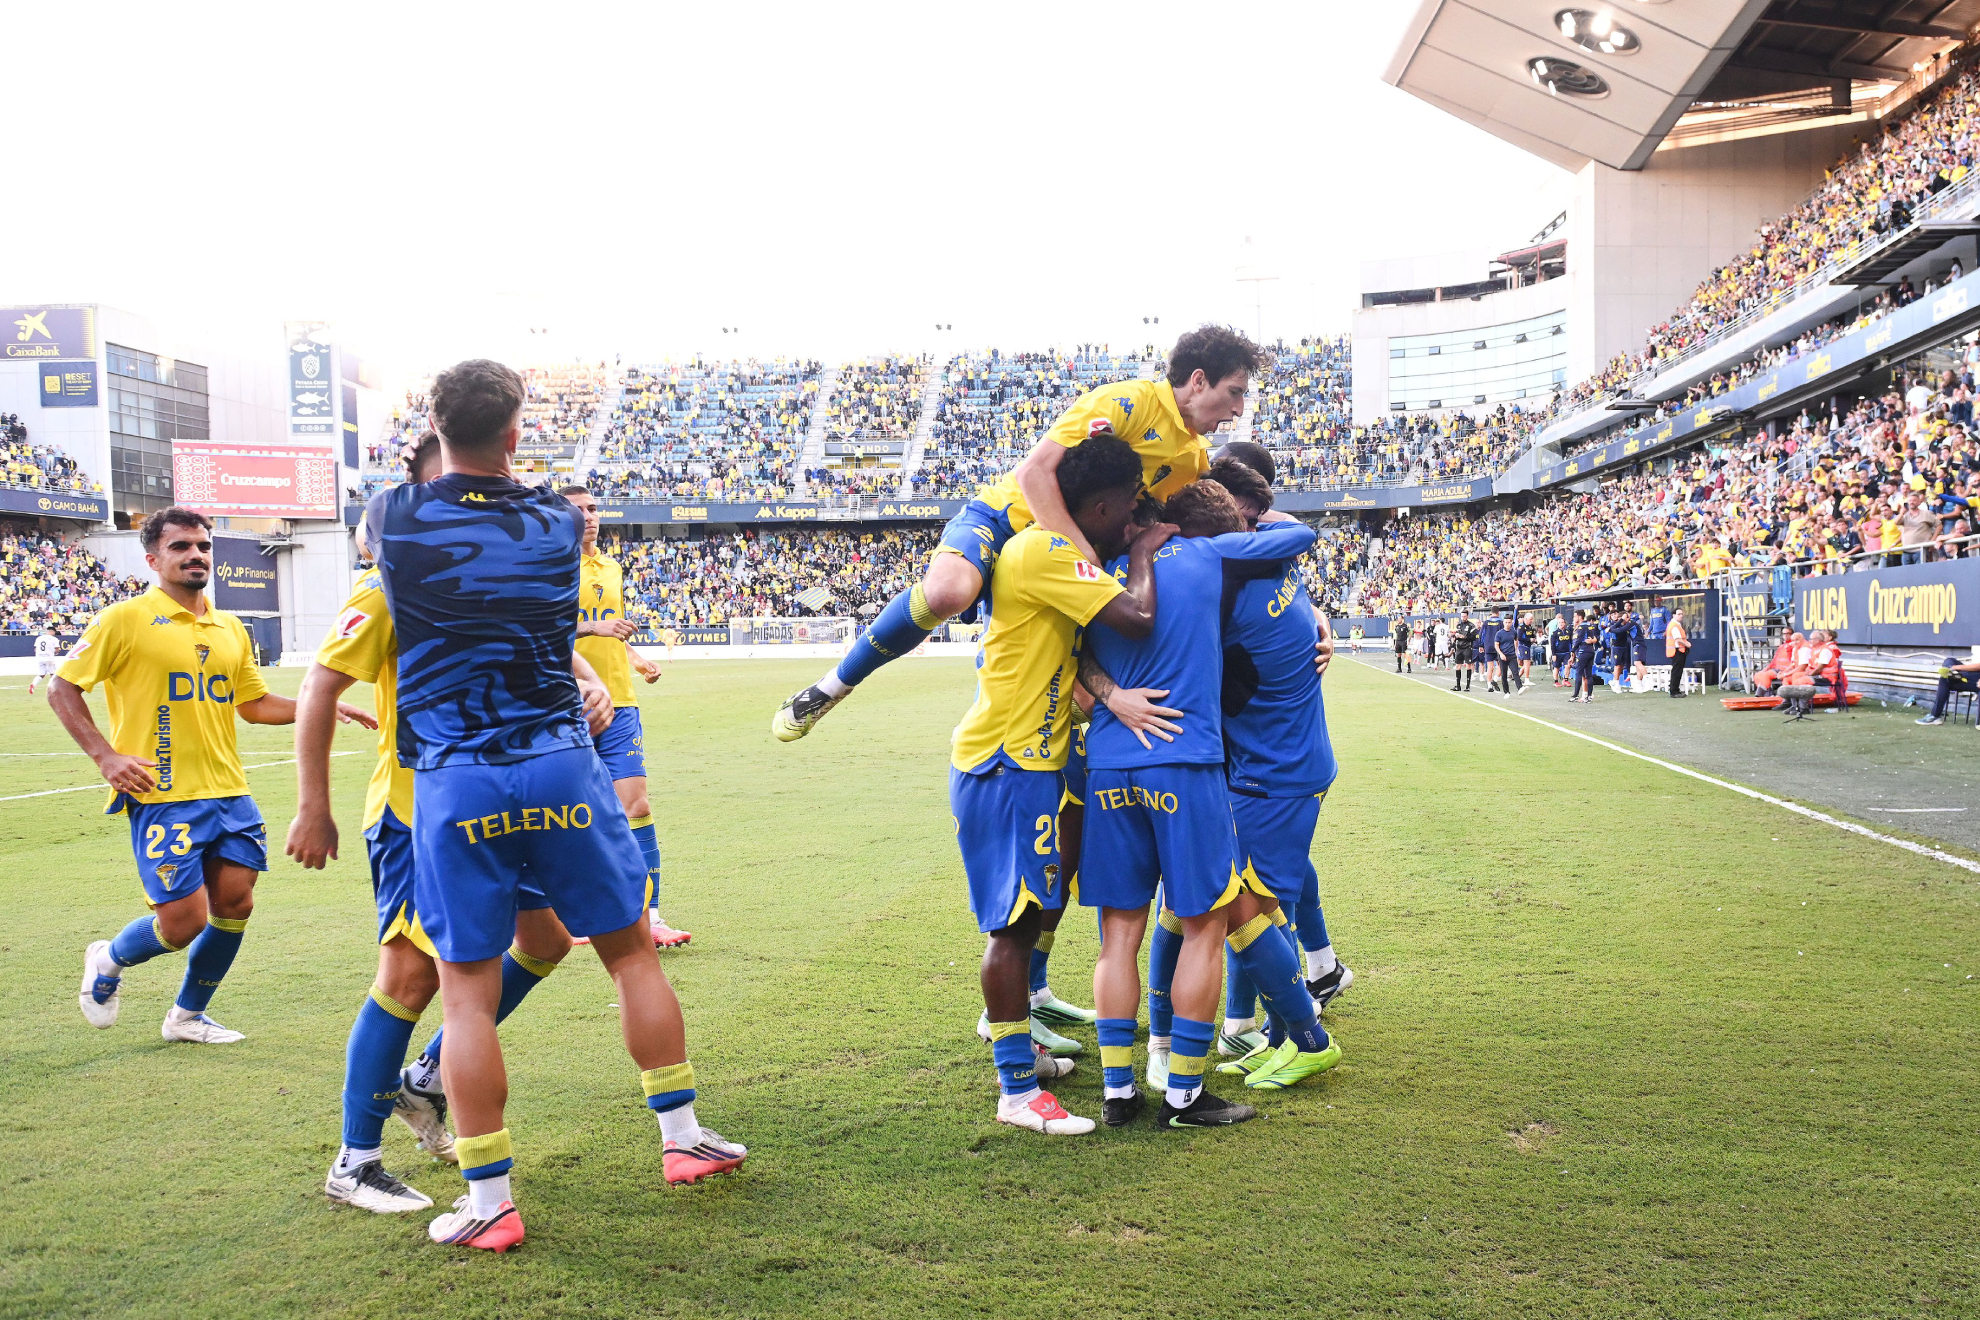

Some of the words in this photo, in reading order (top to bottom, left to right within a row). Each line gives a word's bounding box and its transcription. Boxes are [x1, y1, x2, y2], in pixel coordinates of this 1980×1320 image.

[6, 345, 60, 357] CaixaBank
[65, 372, 92, 381] RESET
[516, 448, 535, 456] rupo
[176, 455, 215, 466] GOL
[295, 459, 332, 469] GOL
[176, 465, 216, 475] GOL
[295, 469, 333, 478] GOL
[177, 474, 217, 484] GOL
[220, 473, 291, 489] Cruzcampo
[296, 477, 333, 487] GOL
[177, 483, 217, 493] GOL
[296, 486, 334, 495] GOL
[177, 492, 218, 502] GOL
[296, 495, 334, 504] GOL
[53, 501, 76, 511] GAMO
[78, 502, 99, 513] BAHÍA
[776, 505, 816, 520] Kappa
[900, 503, 940, 519] Kappa
[233, 567, 245, 578] JP
[245, 567, 276, 580] Financial
[1803, 586, 1849, 631] LALIGA
[1868, 578, 1957, 635] Cruzcampo
[688, 632, 728, 643] PYMES
[1440, 627, 1446, 637] 9
[40, 641, 47, 652] 8
[61, 640, 76, 651] Cai
[1094, 785, 1179, 815] TELENO
[456, 802, 593, 845] TELENO
[146, 823, 193, 860] 23
